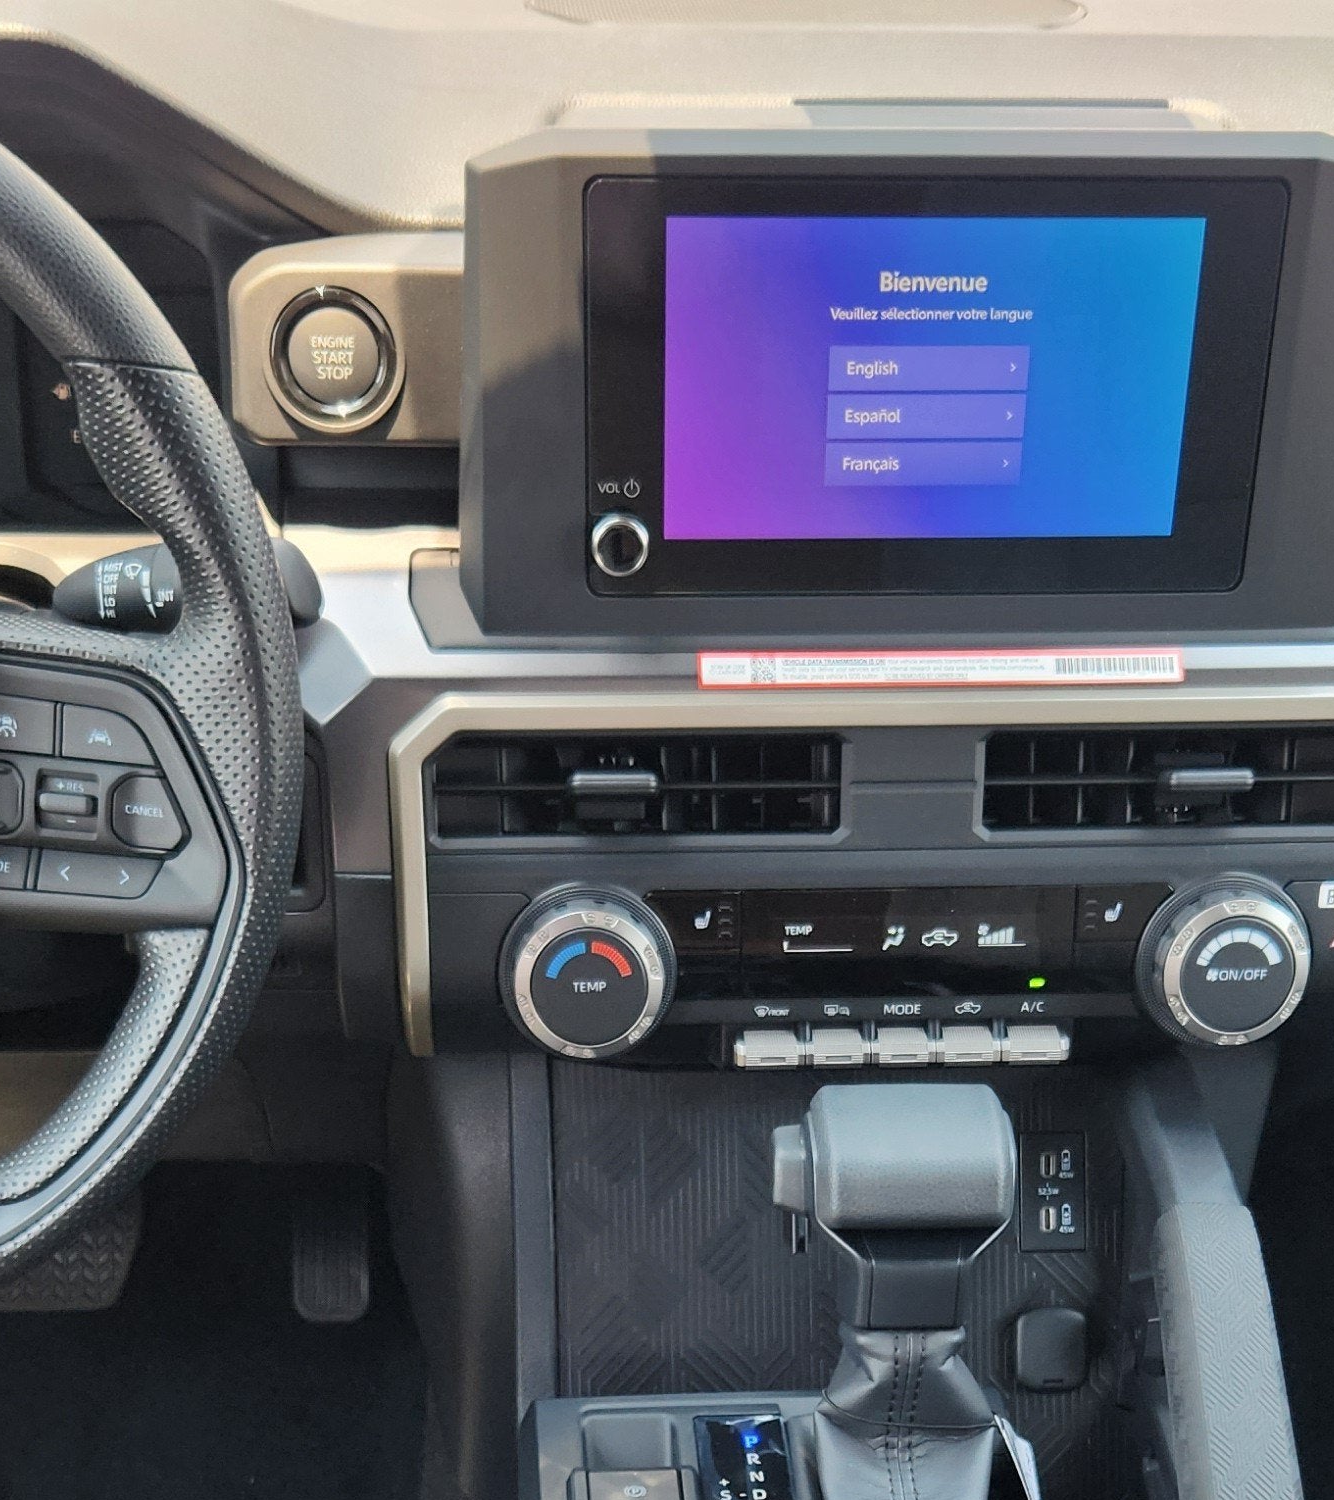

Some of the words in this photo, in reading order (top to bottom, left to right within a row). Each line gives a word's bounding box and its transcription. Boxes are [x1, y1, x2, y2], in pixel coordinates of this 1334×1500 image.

[879, 270, 989, 293] Bienvenue
[829, 307, 879, 321] Veuillez
[880, 307, 955, 321] sélectionner
[956, 308, 988, 321] votre
[989, 308, 1033, 324] langue
[310, 335, 355, 349] ENGINE
[312, 351, 354, 365] START
[317, 366, 353, 380] STOP
[846, 361, 899, 378] English
[844, 409, 902, 426] Español
[842, 456, 900, 475] Français
[597, 482, 621, 494] VOL
[103, 573, 119, 584] OFF
[124, 804, 164, 818] CANCEL
[784, 925, 813, 936] TEMP
[1219, 968, 1268, 982] ON/OFF
[572, 981, 607, 993] TEMP
[769, 1008, 790, 1017] FRONT
[883, 1003, 922, 1016] MODE
[1020, 1001, 1045, 1014] A/C
[744, 1436, 758, 1448] P
[746, 1453, 762, 1465] R
[750, 1471, 765, 1483] N
[720, 1489, 733, 1500] S
[752, 1489, 768, 1500] D
